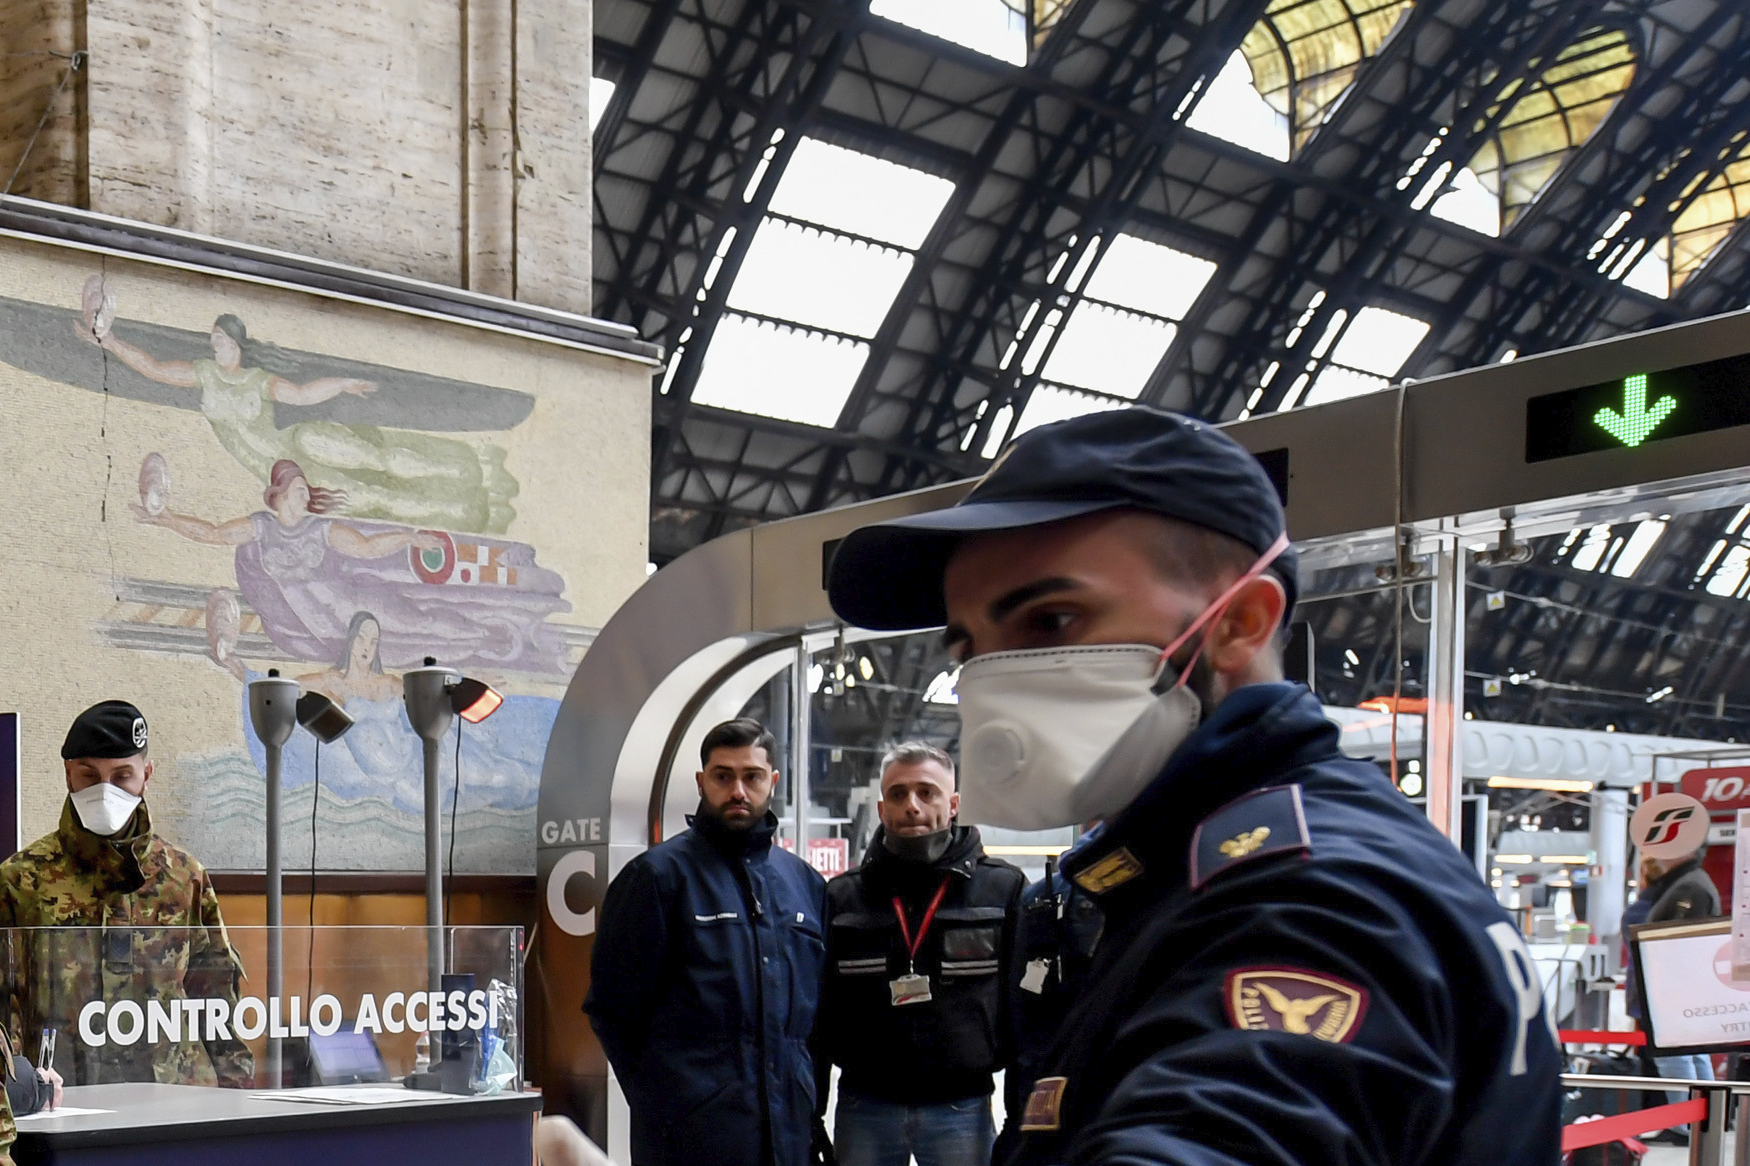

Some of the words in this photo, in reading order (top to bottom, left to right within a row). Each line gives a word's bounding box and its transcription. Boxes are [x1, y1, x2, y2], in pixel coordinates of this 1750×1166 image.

[1701, 776, 1750, 803] 10
[541, 817, 601, 844] GATE
[547, 850, 596, 937] C
[78, 993, 343, 1047] CONTROLLO
[354, 990, 499, 1035] ACCESSI
